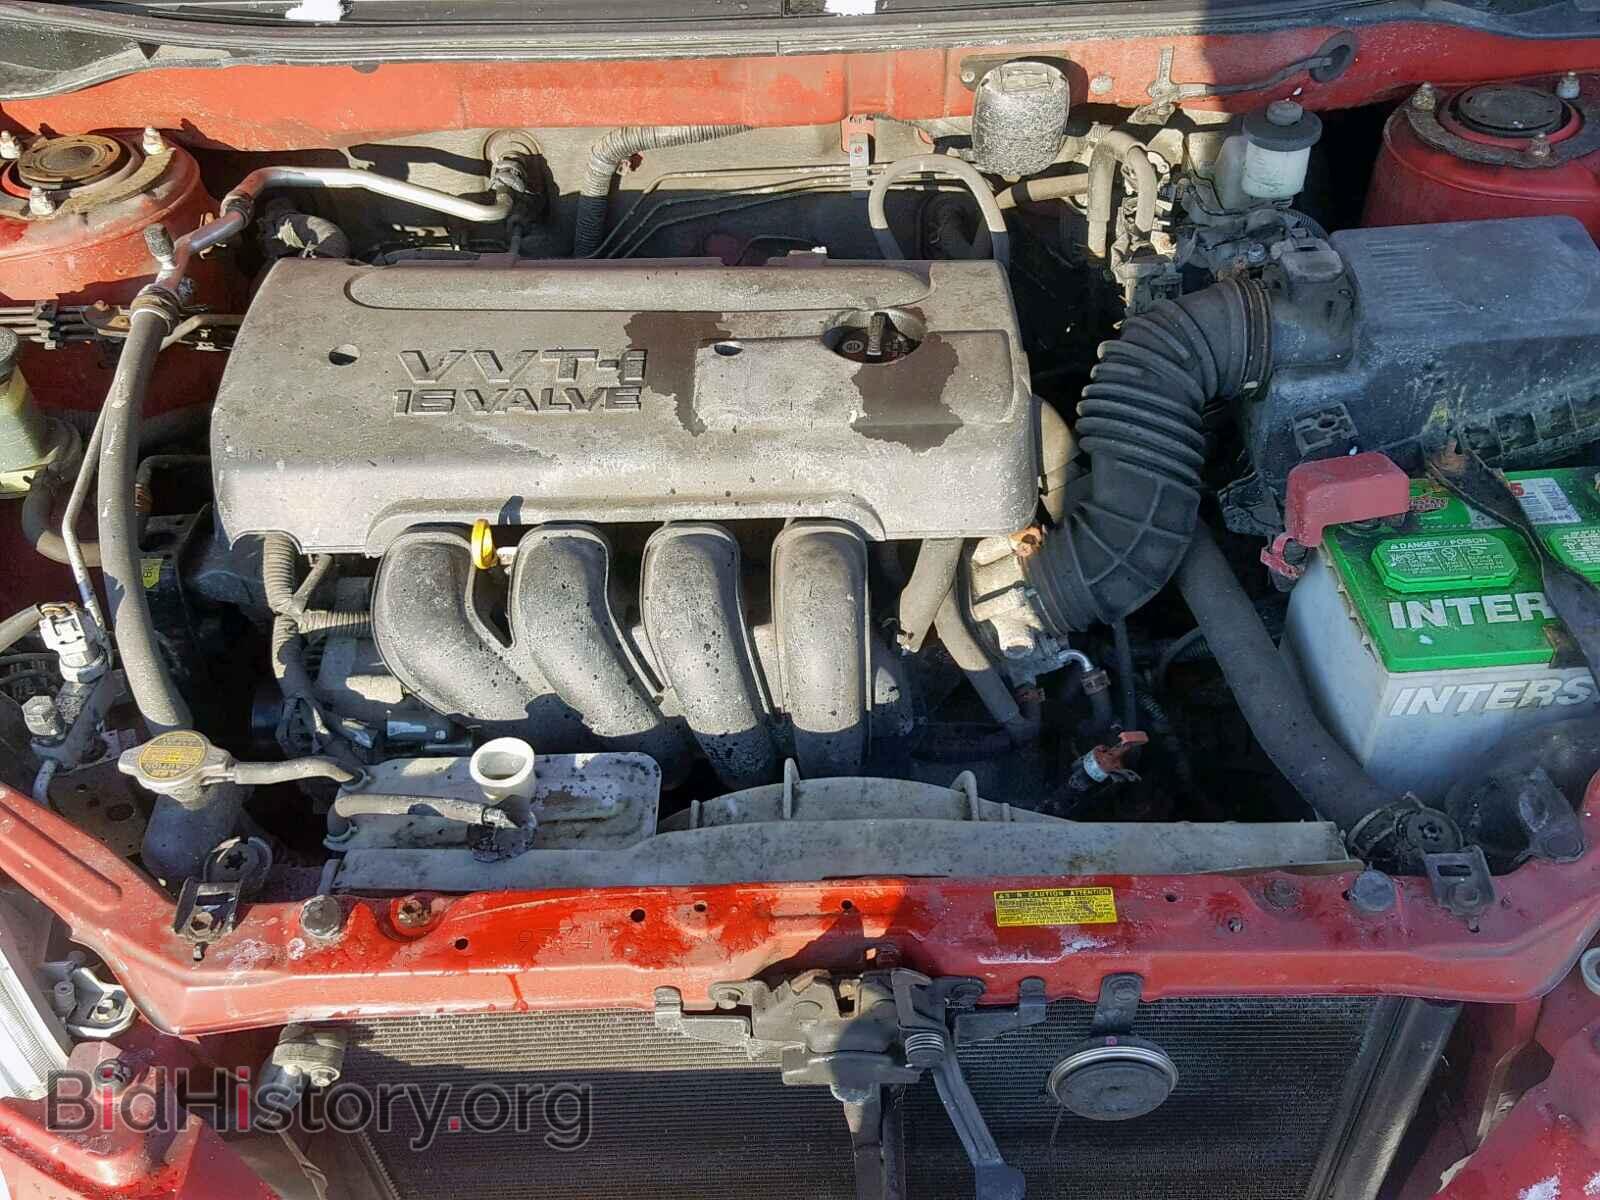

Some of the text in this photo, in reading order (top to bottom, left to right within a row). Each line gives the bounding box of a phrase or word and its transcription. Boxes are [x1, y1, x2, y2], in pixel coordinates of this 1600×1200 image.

[393, 386, 642, 415] 16 VALVE
[1400, 540, 1441, 550] DANGER
[1450, 537, 1488, 546] POISON
[1388, 592, 1558, 629] INTER
[1389, 675, 1594, 717] INTERS
[1070, 888, 1109, 896] ATTENTION
